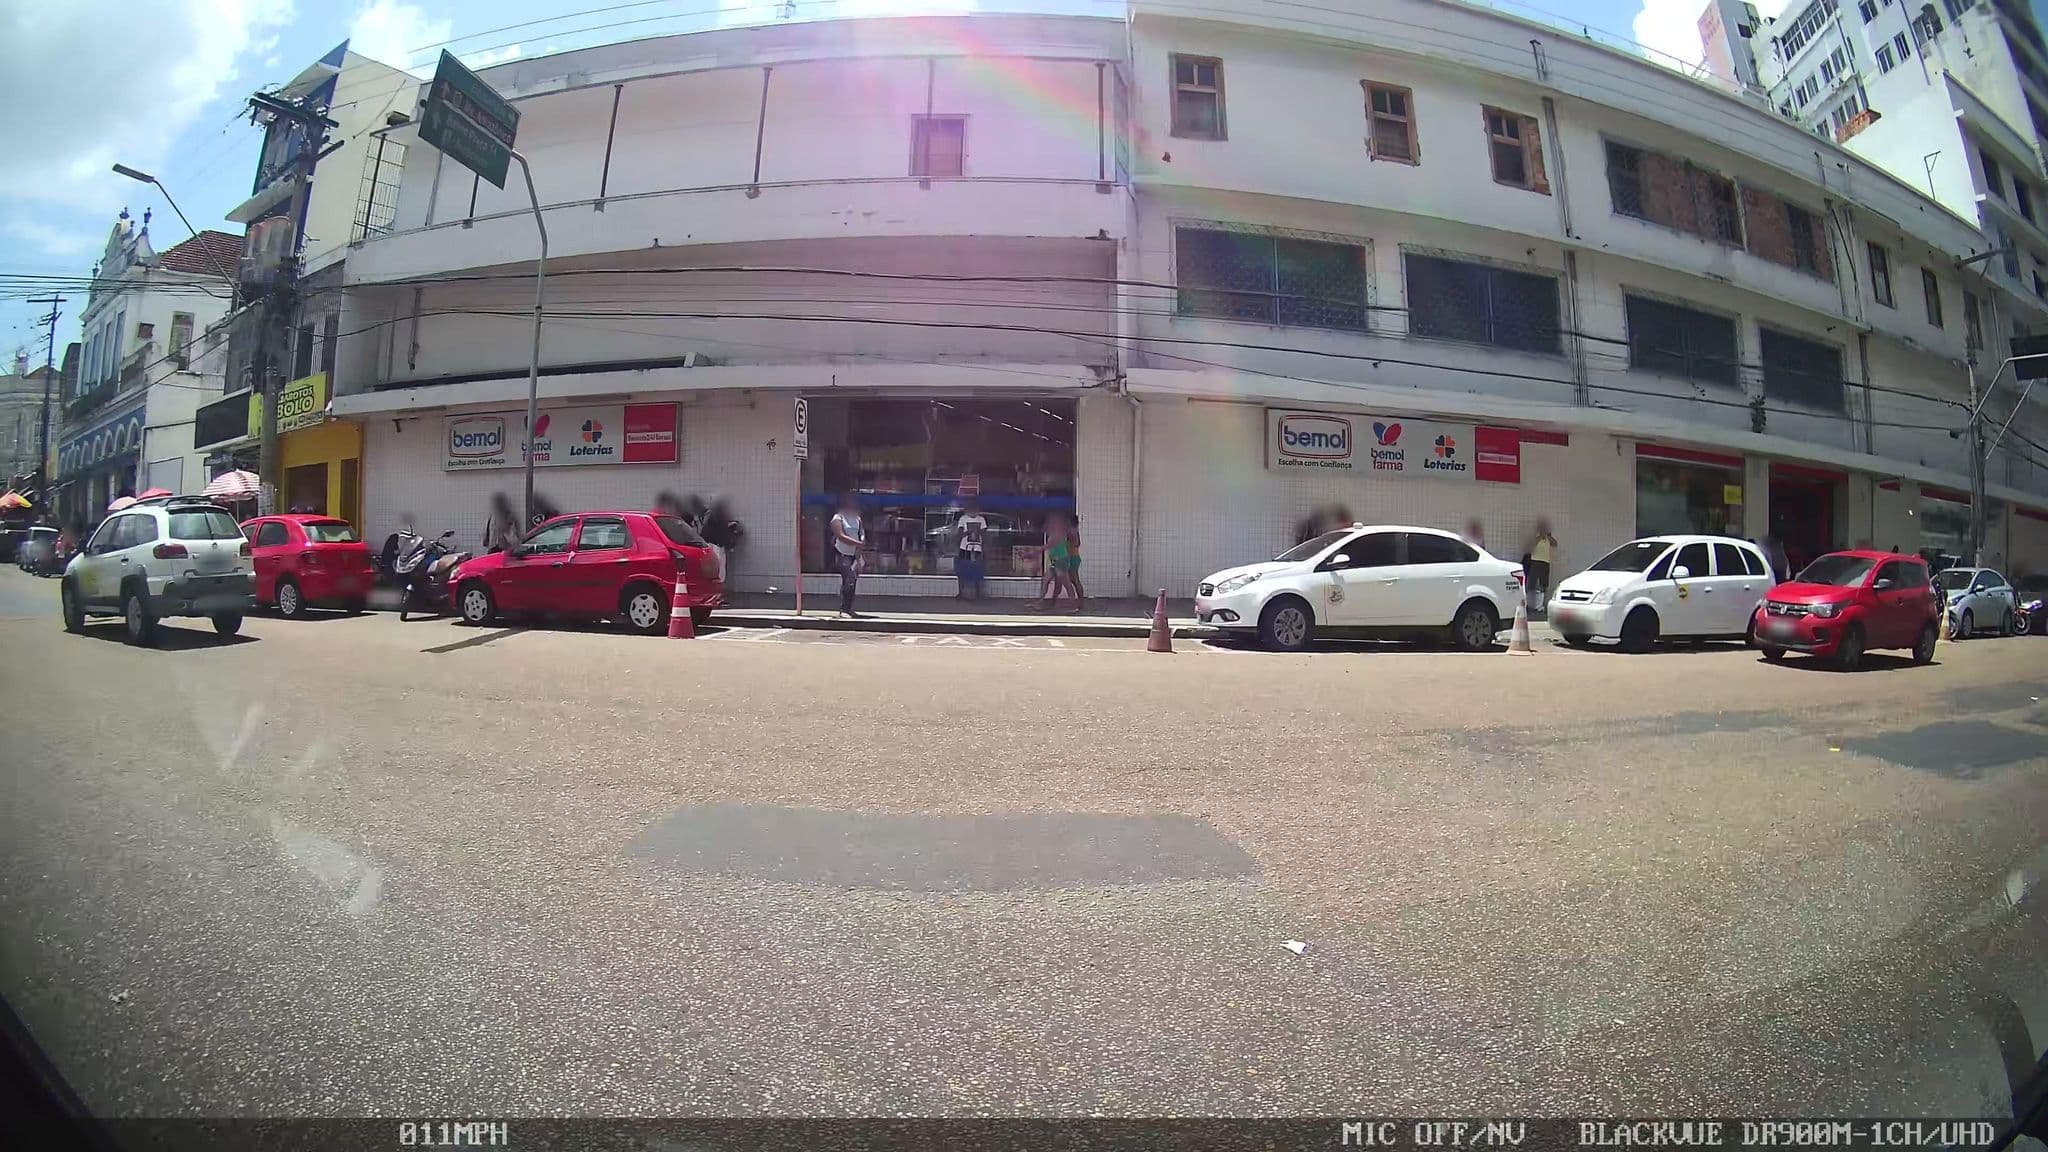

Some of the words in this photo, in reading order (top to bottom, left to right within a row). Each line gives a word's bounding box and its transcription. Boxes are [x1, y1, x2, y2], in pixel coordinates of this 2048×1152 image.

[278, 396, 315, 419] BOLO
[453, 427, 501, 448] bemol
[1284, 425, 1346, 449] bemol
[521, 439, 552, 451] bmol
[570, 445, 613, 456] Loterias
[1371, 447, 1405, 461] bemol
[1278, 458, 1303, 466] Escolha
[1320, 460, 1352, 470] Confiança
[1373, 460, 1403, 471] farma
[1424, 458, 1466, 471] Loterias
[896, 635, 1065, 648] TAXI
